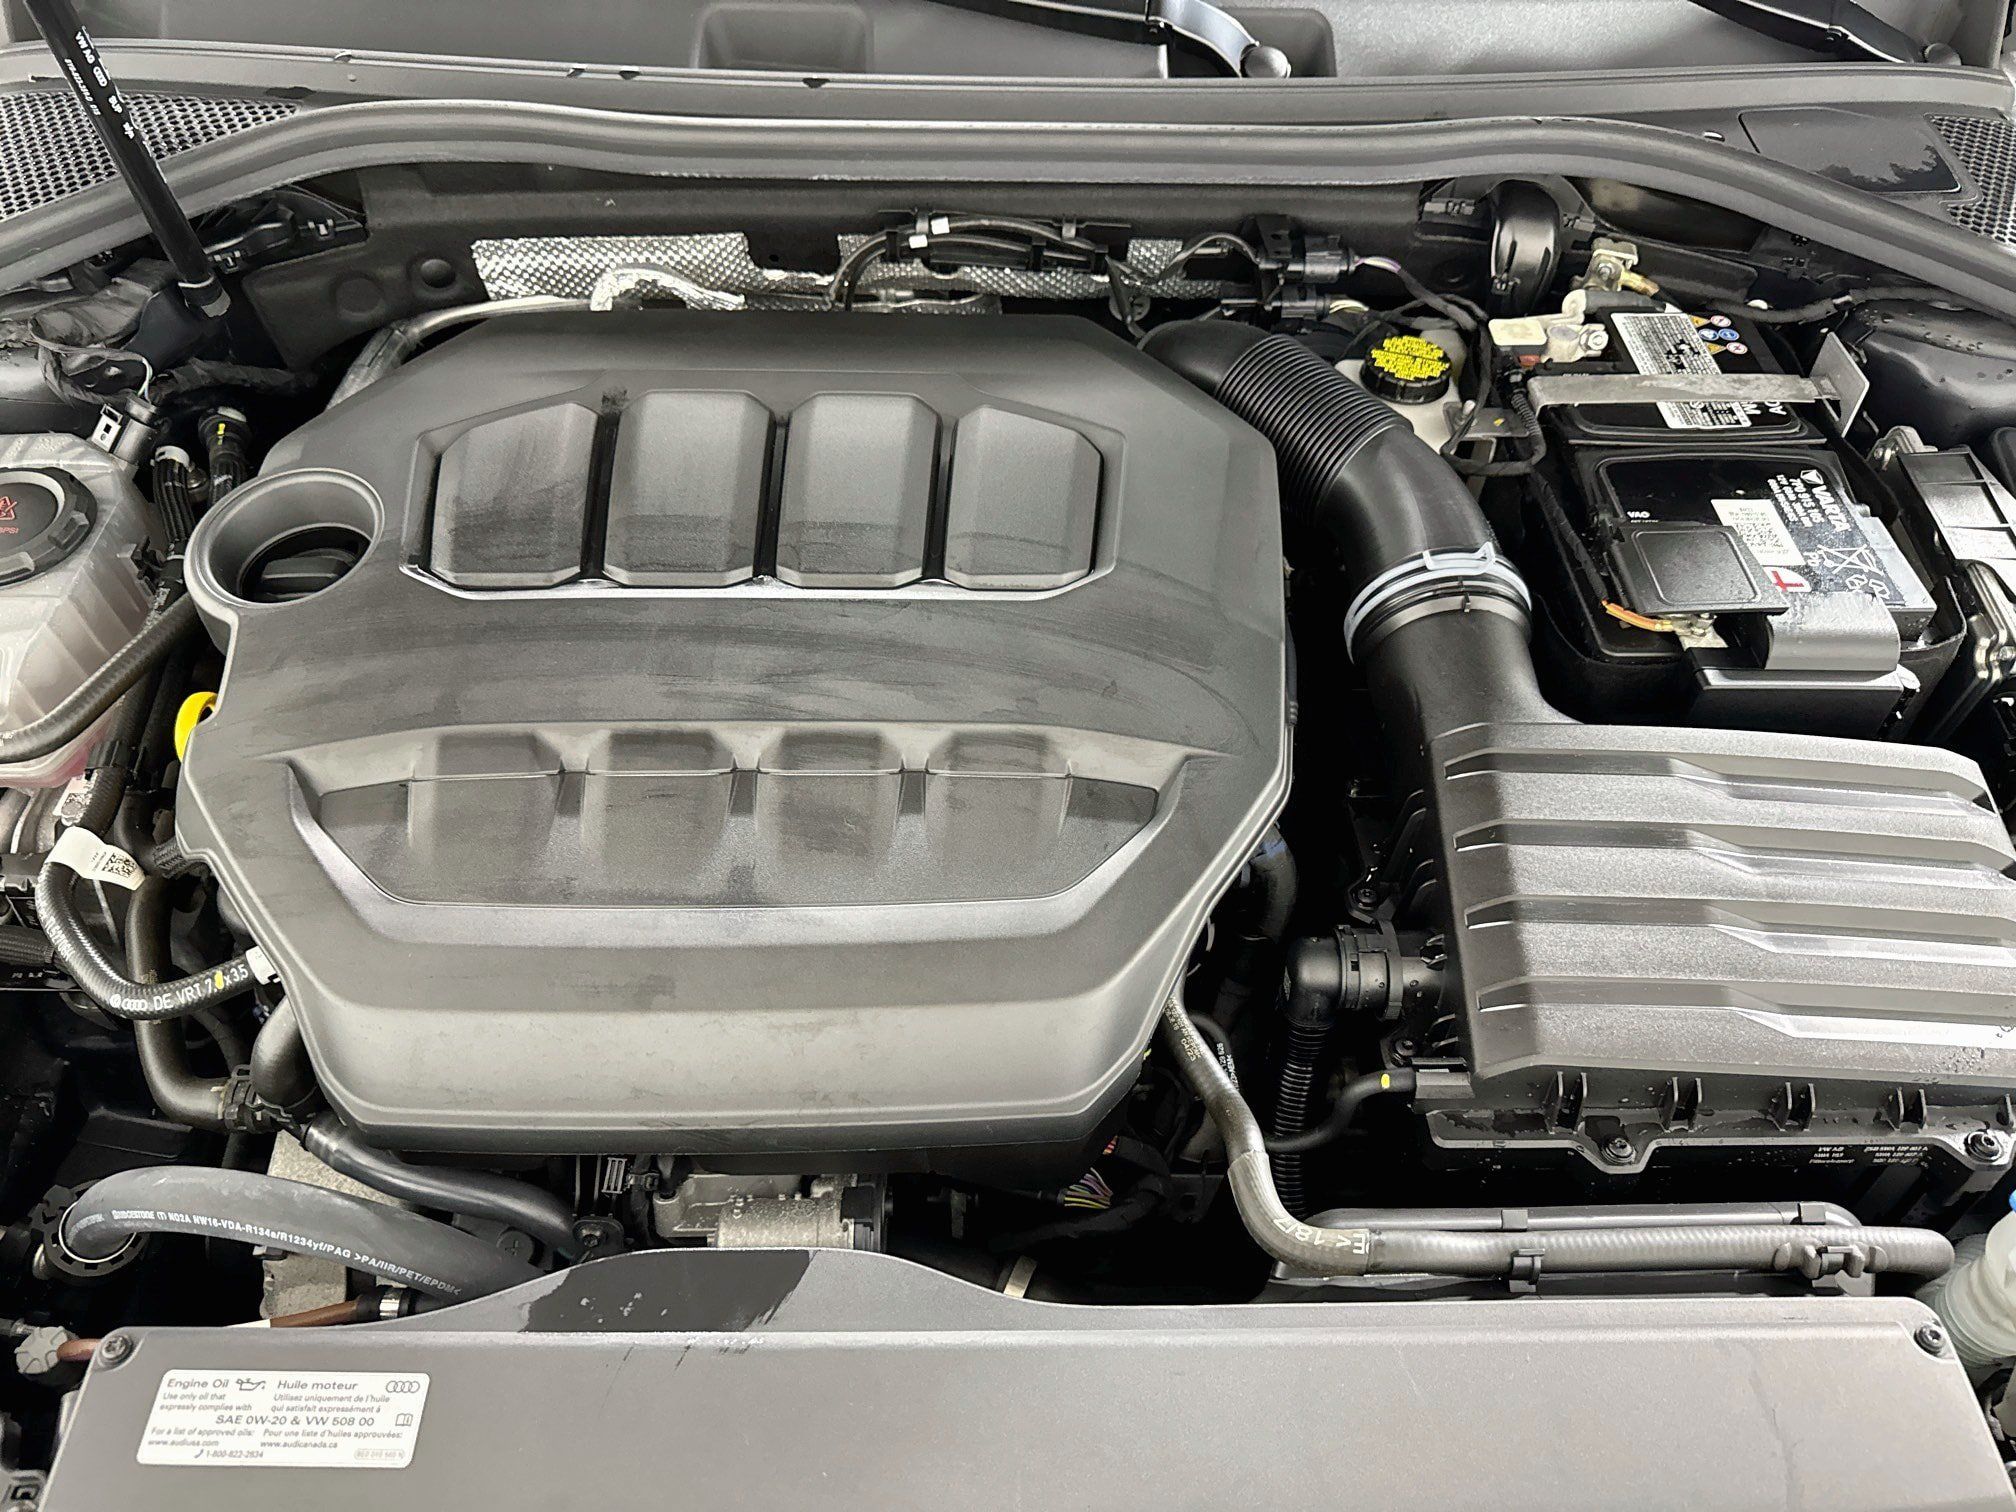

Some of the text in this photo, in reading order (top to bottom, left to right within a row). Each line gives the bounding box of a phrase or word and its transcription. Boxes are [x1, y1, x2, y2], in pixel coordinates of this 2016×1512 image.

[1811, 484, 1850, 532] VARTA
[153, 992, 174, 1011] DE
[176, 982, 203, 1004] VRT
[112, 1210, 156, 1220] BRIDGESTONE
[167, 1378, 230, 1390] Engine Oil
[277, 1380, 359, 1390] Huile moteur
[163, 1392, 226, 1403] Use only oil that
[273, 1393, 302, 1402] Utilisez
[304, 1394, 352, 1404] uniquement
[353, 1394, 364, 1403] de
[160, 1402, 253, 1412] expressly complies with
[270, 1404, 284, 1414] qui
[285, 1404, 317, 1413] satisfait
[215, 1414, 375, 1427] SAE 0W-20 & VW 508 00
[151, 1427, 165, 1436] For
[173, 1427, 186, 1436] list
[187, 1427, 197, 1436] of
[197, 1427, 237, 1438] approved
[263, 1428, 283, 1438] Pour
[284, 1429, 299, 1438] une
[301, 1428, 319, 1438] liste
[147, 1439, 220, 1447] www.audiusa.com
[260, 1440, 338, 1449] www.audicanada.ca
